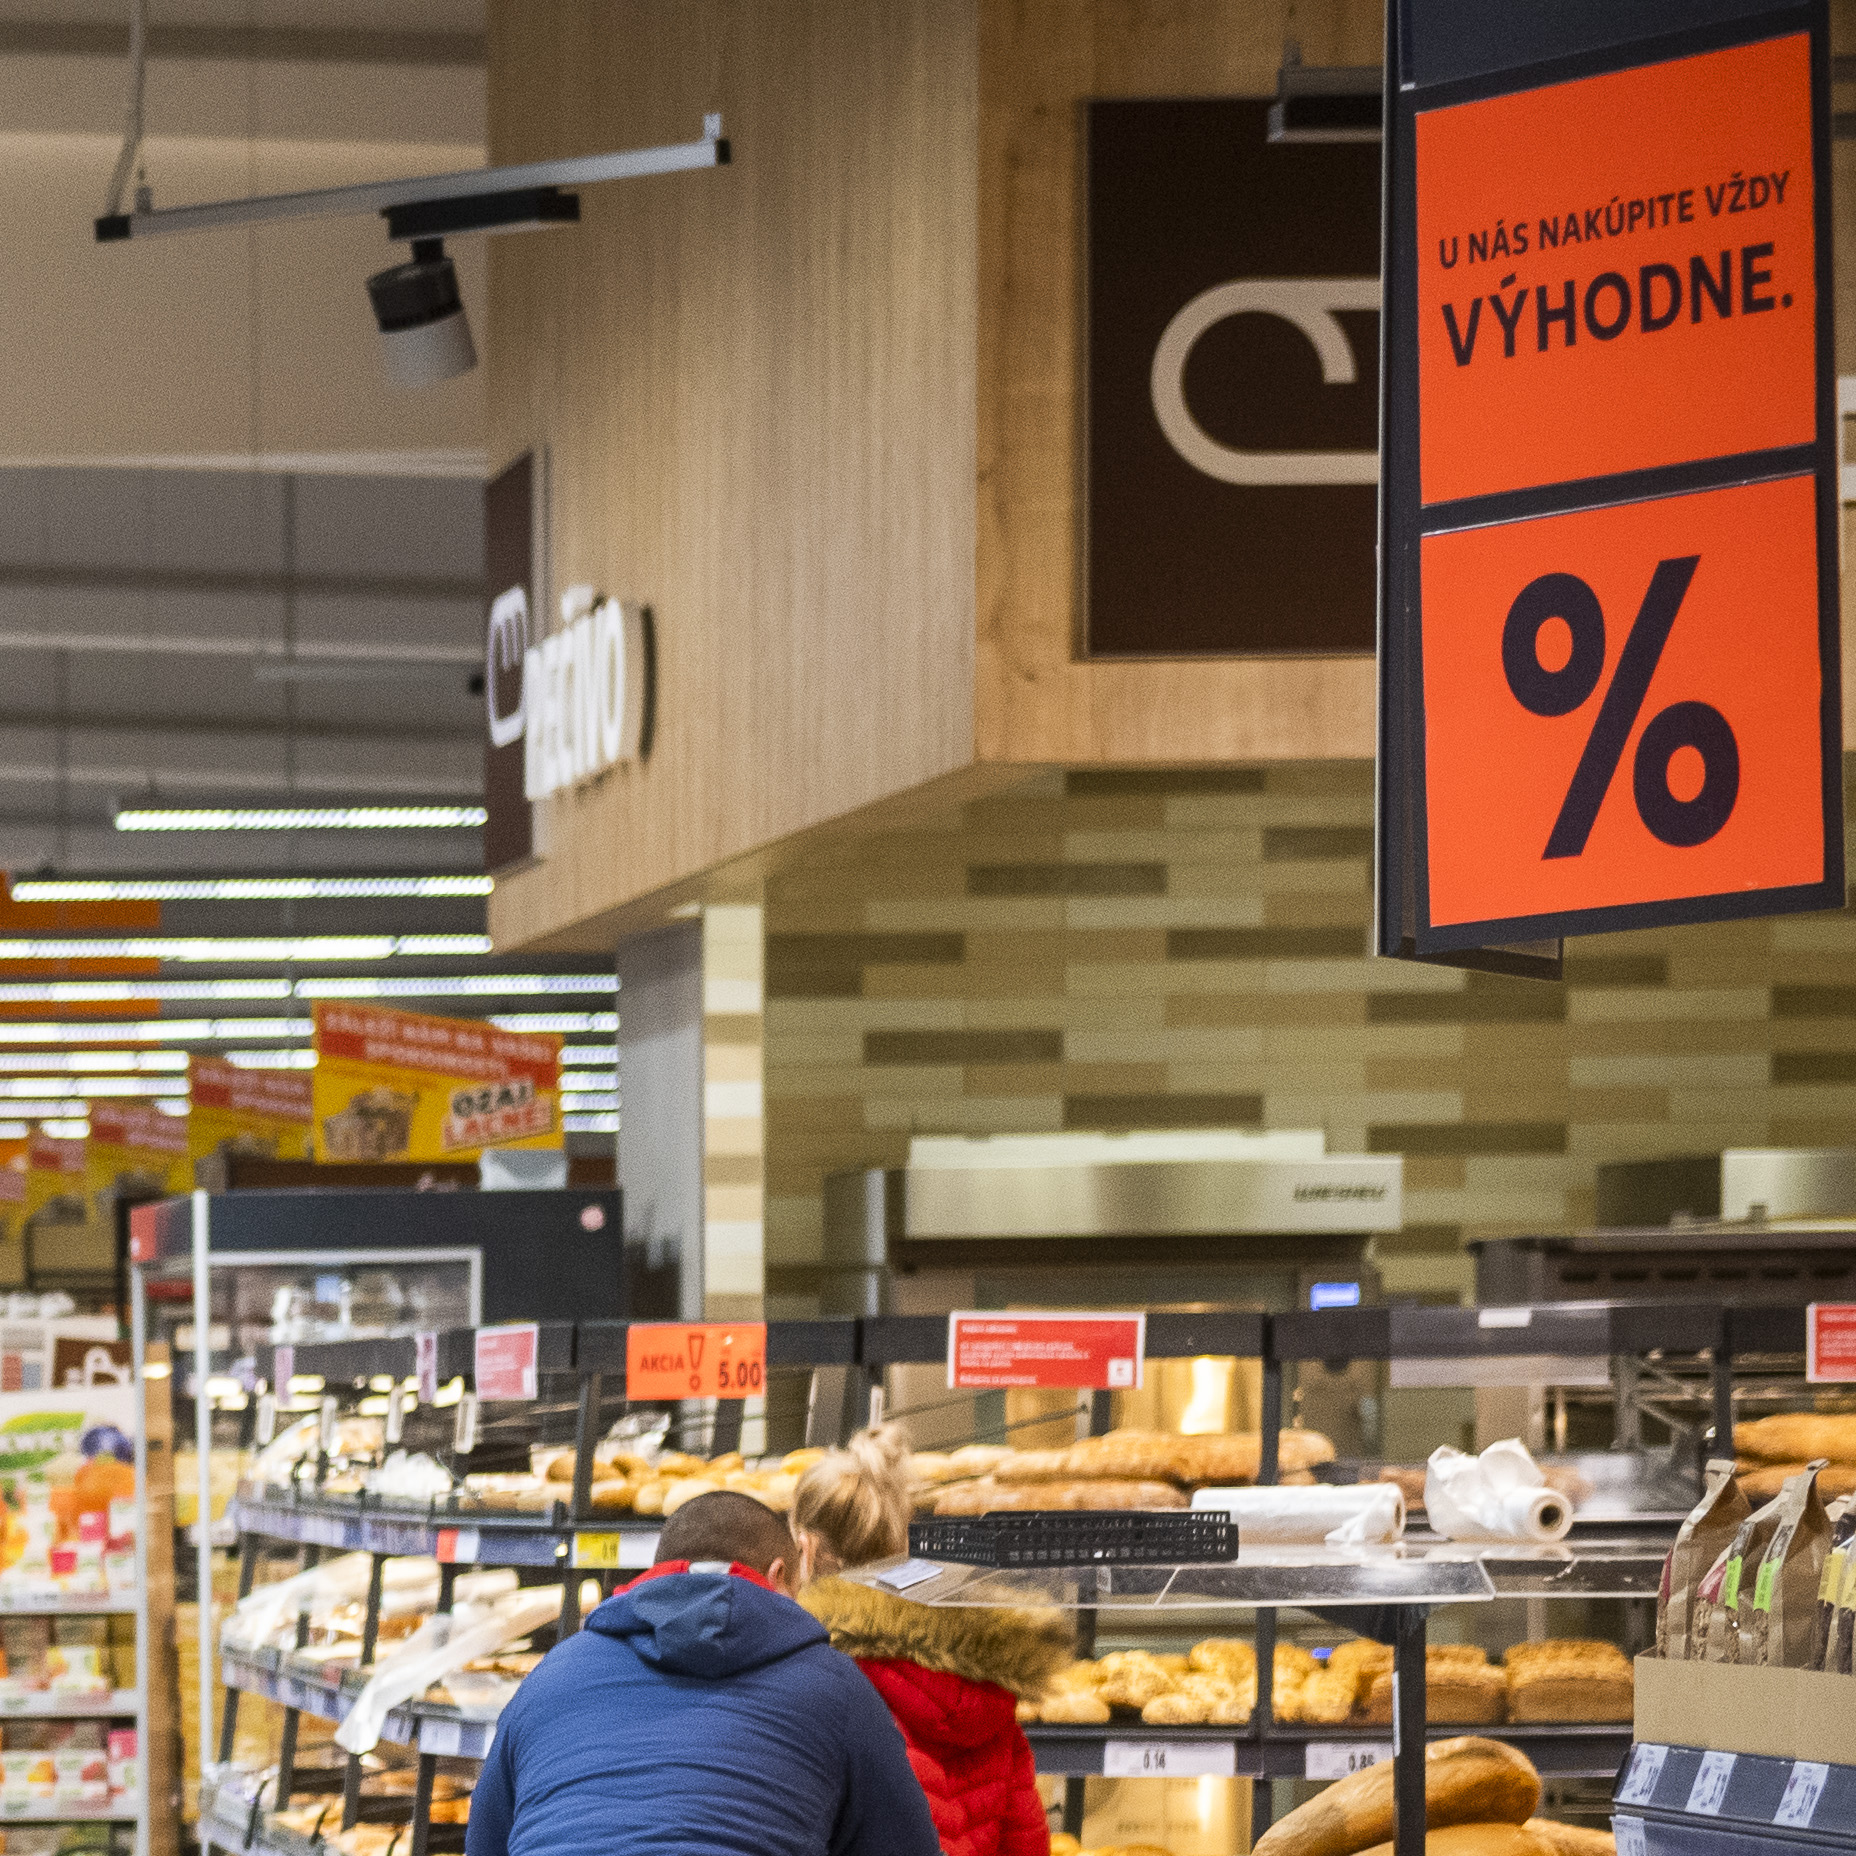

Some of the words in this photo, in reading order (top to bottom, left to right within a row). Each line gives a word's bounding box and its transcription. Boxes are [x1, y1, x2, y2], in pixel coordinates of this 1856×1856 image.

[1439, 235, 1458, 269] U
[1468, 219, 1529, 263] NÁS
[1539, 196, 1695, 250] NAKÚPITE
[1705, 170, 1790, 217] VŽDY
[1442, 241, 1793, 367] VÝHODNE.
[1501, 554, 1741, 849] %
[639, 1354, 685, 1373] AKCIA
[718, 1360, 761, 1389] 5.00
